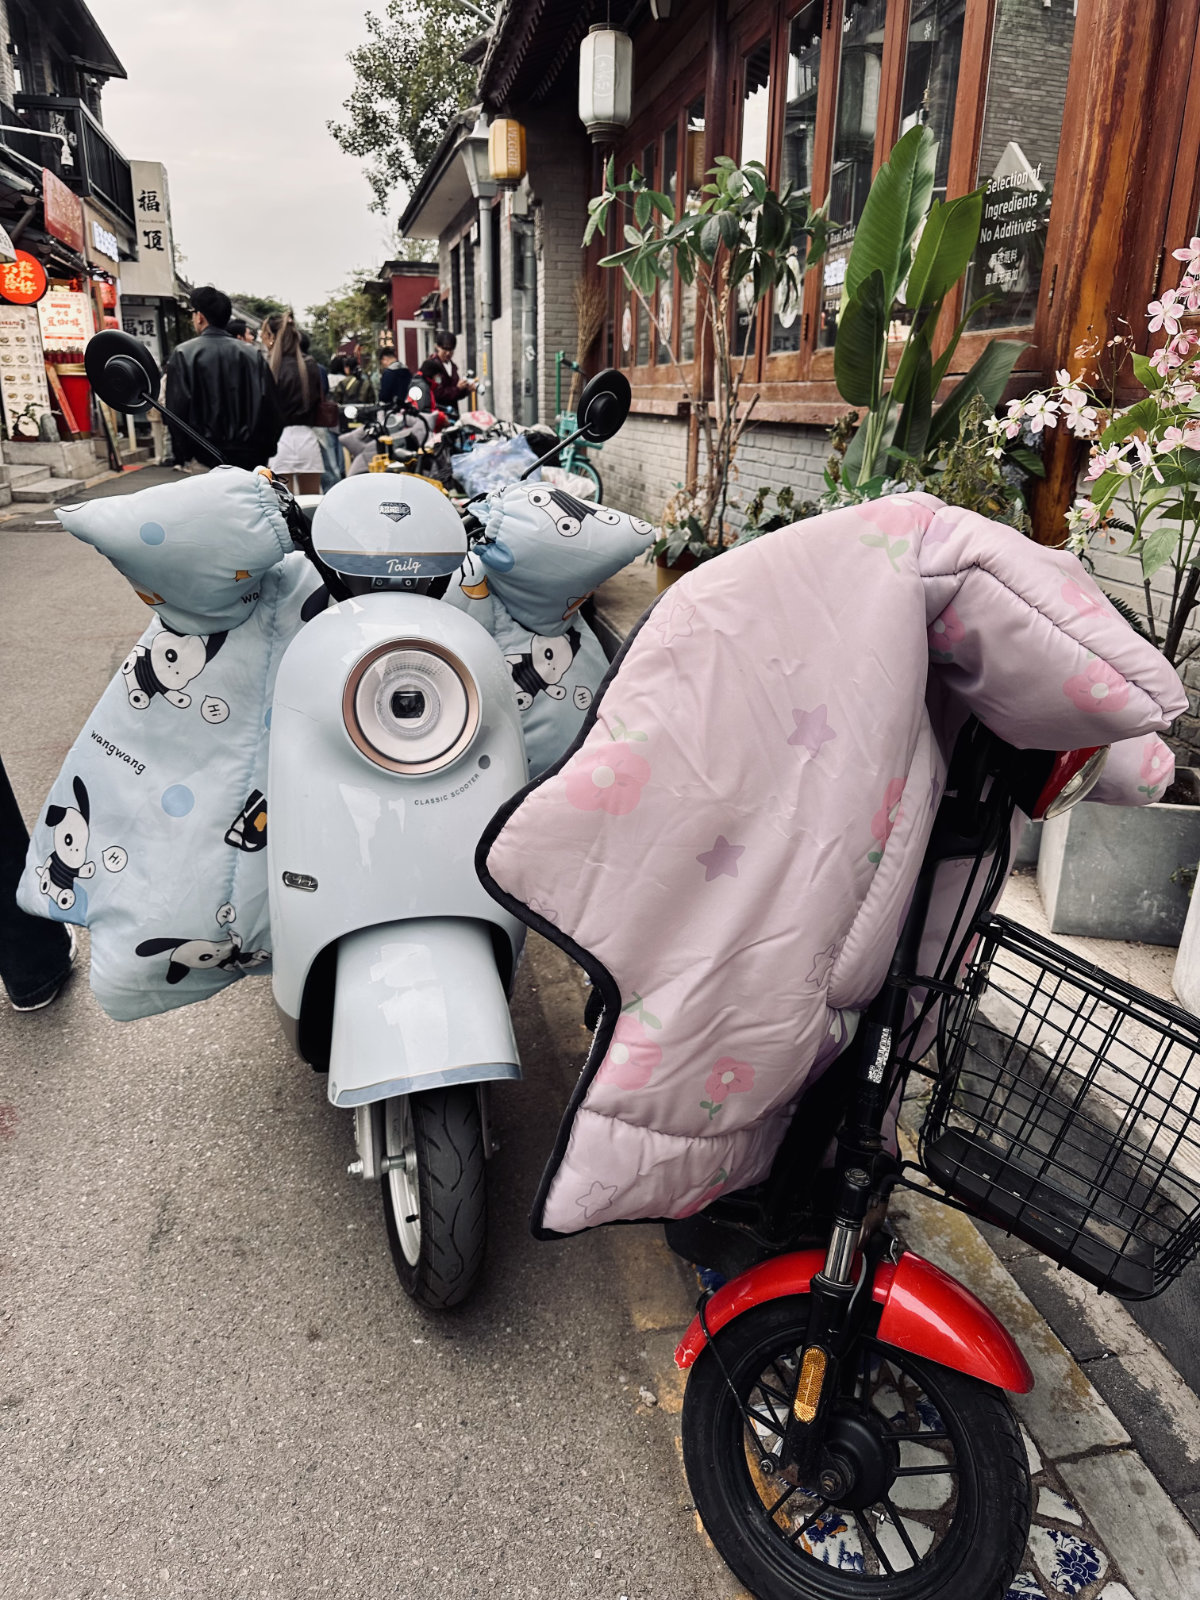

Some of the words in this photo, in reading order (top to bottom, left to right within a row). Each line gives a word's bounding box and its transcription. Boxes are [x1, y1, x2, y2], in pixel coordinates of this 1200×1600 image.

[507, 127, 519, 168] VEGGIE
[986, 170, 1028, 194] Selection
[1031, 163, 1042, 181] of
[137, 189, 165, 252] 福顶
[985, 192, 1038, 220] Ingredients
[980, 227, 993, 243] No
[993, 219, 1037, 241] Additives
[207, 704, 222, 717] Hi
[577, 691, 588, 704] Hi
[90, 730, 146, 776] wangwang
[414, 794, 449, 806] CLASSIC
[450, 773, 480, 798] SCOOTER
[108, 851, 123, 865] Hi
